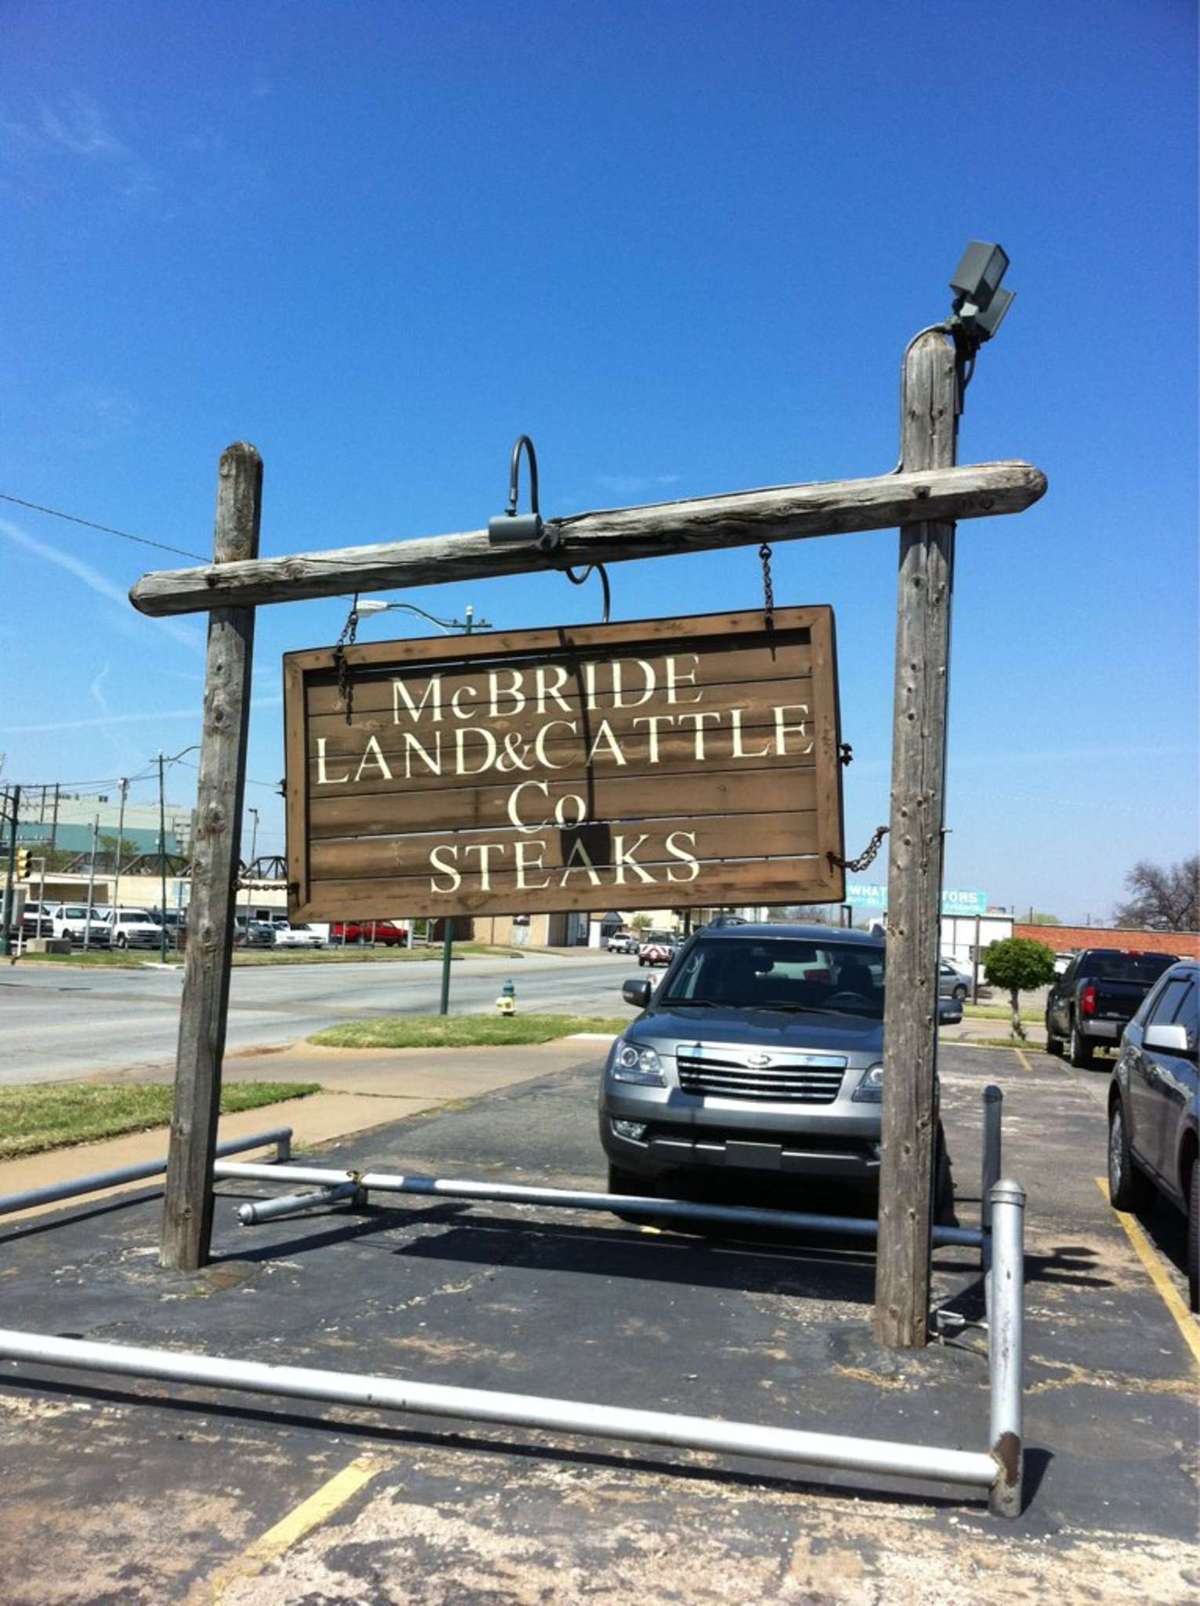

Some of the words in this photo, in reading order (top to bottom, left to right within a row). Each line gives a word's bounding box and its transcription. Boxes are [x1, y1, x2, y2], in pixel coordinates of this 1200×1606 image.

[391, 654, 705, 724] McBRIDE
[506, 779, 588, 835] Co
[428, 830, 702, 895] STEAKS
